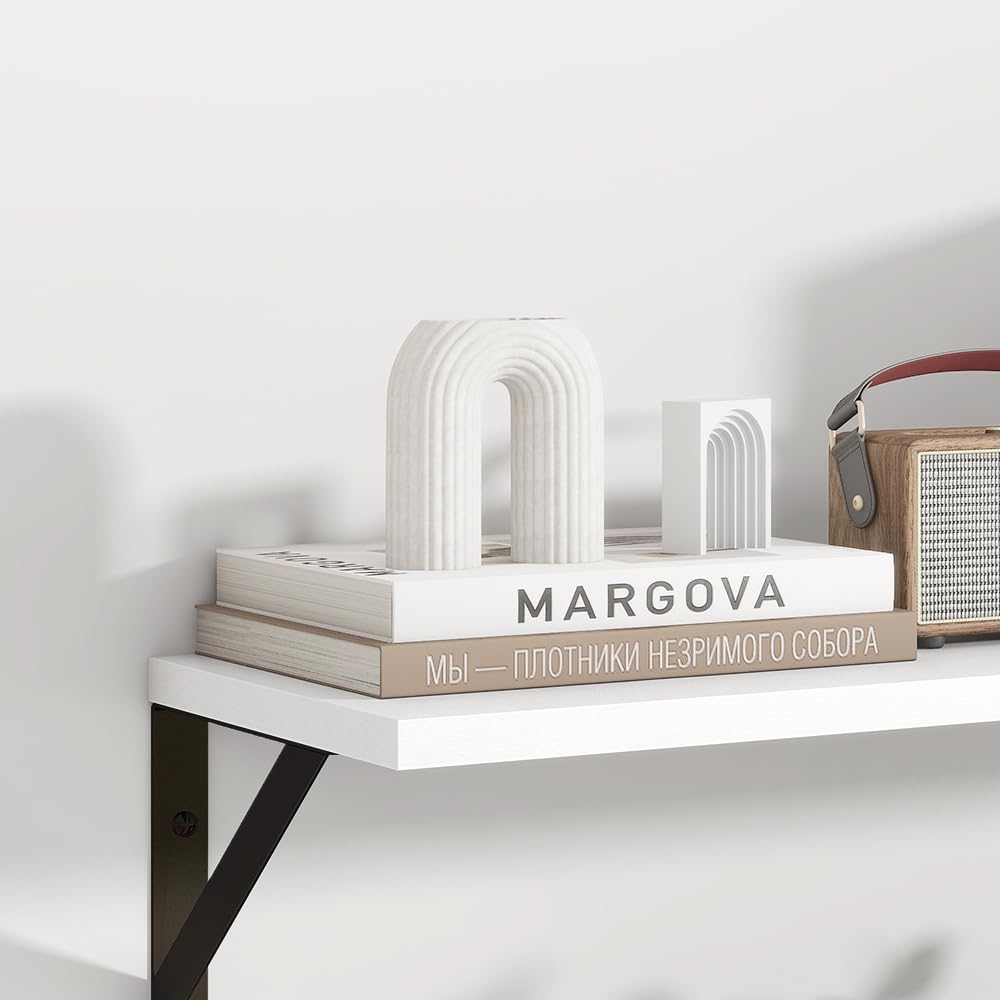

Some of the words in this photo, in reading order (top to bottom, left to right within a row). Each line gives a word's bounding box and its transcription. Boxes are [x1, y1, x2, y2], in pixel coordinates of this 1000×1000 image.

[517, 574, 786, 624] MARGOVA
[426, 653, 469, 687] МЫ
[513, 641, 640, 680] ПЛОТНИКИ
[649, 631, 785, 670] НЕЗРИМОГО
[792, 625, 880, 661] СОБОРА
